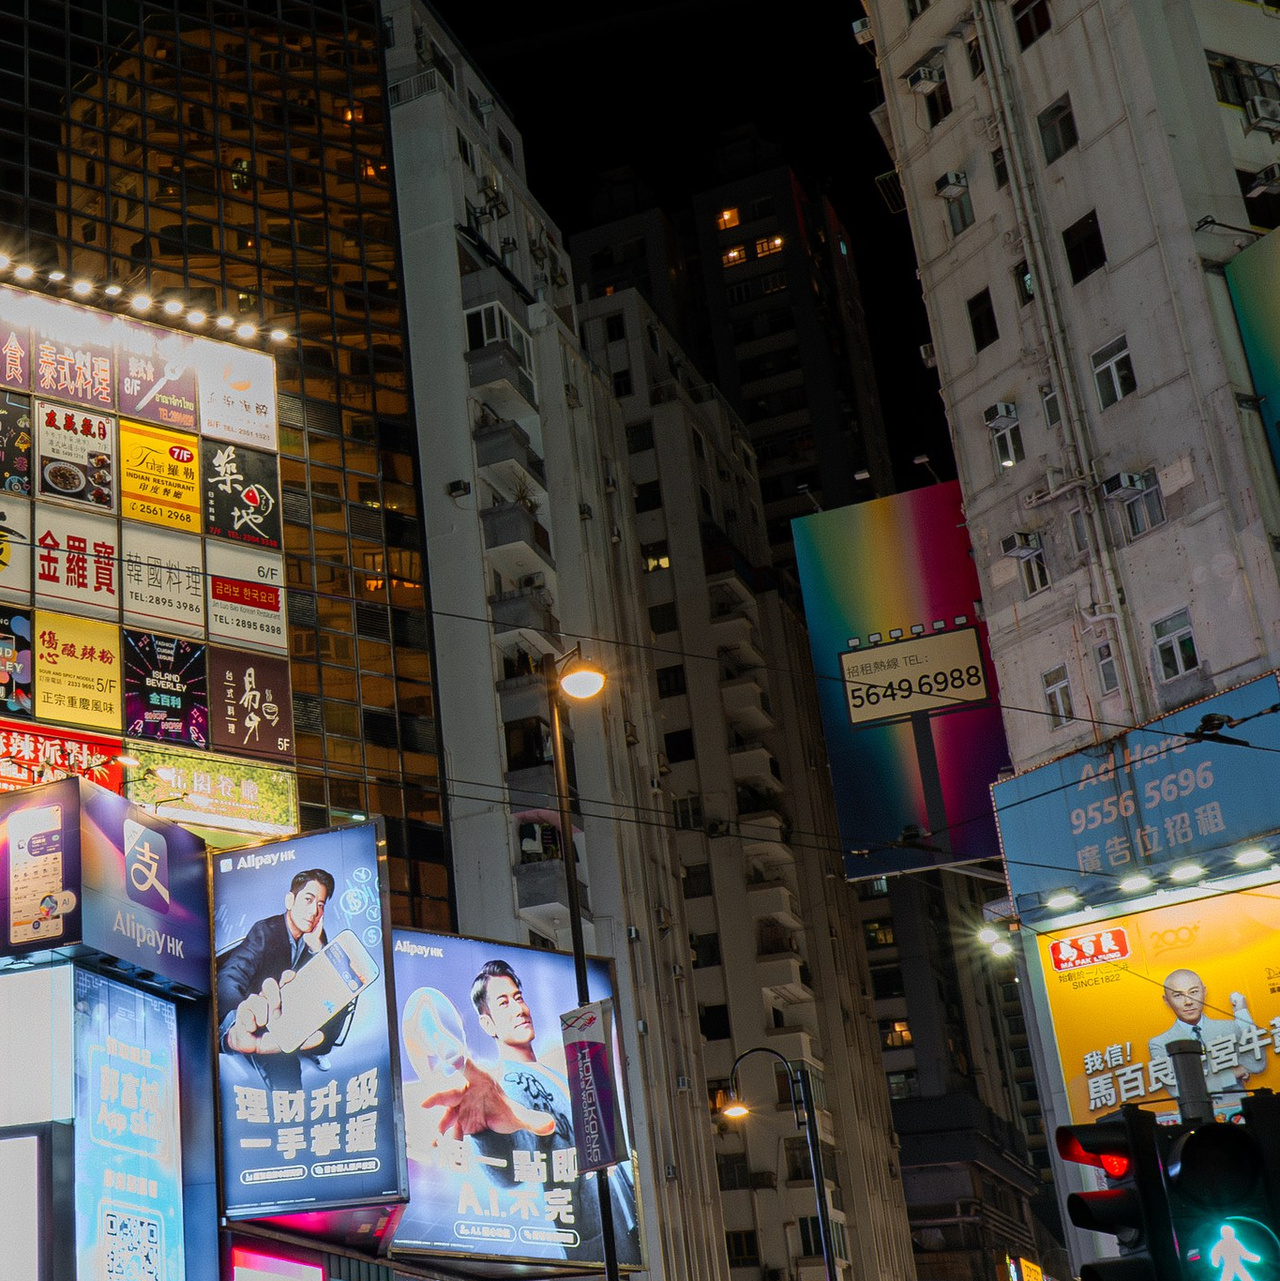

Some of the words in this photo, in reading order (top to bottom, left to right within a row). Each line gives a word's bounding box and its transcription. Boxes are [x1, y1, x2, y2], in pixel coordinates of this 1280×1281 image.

[39, 341, 111, 404] 泰式料理
[124, 377, 141, 396] 8/F
[45, 410, 96, 438] 友義氣
[172, 447, 191, 460] 7/F
[126, 471, 150, 483] INDIAN
[153, 478, 195, 492] RESTAURANT
[167, 463, 195, 480] 羅勒
[138, 483, 182, 500] 印度餐廳
[140, 503, 163, 517] 2561
[168, 510, 191, 523] 2968
[38, 530, 115, 596] 金羅寶
[126, 551, 202, 597] 韓國料理
[257, 565, 278, 580] 6/F
[215, 581, 239, 598] 금라보
[243, 588, 276, 605] 한국요리
[176, 602, 201, 614] 3986
[259, 621, 282, 635] 6398
[152, 670, 180, 682] ISLAND
[846, 657, 900, 679] 招租熱線
[96, 677, 117, 694] 5/F
[145, 677, 187, 692] BEVERLEY
[851, 678, 913, 709] 5649
[918, 665, 982, 695] 6988
[41, 691, 116, 715] 正宗重慶風味
[149, 692, 182, 709] 金百利
[225, 670, 236, 734] 台式料理
[277, 738, 291, 751] 5F
[1077, 753, 1115, 791] Ad
[1124, 734, 1187, 774] Here
[1070, 790, 1136, 835] 9556
[1144, 760, 1214, 810] 5696
[1076, 801, 1226, 877] 廣告位招租
[237, 849, 296, 870] AlipayHK
[62, 898, 70, 906] AI
[113, 910, 184, 959] AlipayHK
[1058, 931, 1120, 962] 馬百良
[394, 939, 443, 958] AlipayHK
[1060, 961, 1074, 970] MA
[1075, 957, 1092, 967] PAK
[1084, 1041, 1132, 1074] 我信!
[577, 1052, 585, 1088] ASIA'S
[582, 1048, 596, 1103] HONG
[234, 1067, 378, 1123] 理財升級
[97, 1102, 127, 1137] App
[581, 1092, 591, 1134] WORLD
[240, 1111, 377, 1160] 一手掌握
[587, 1106, 601, 1162] KONG
[585, 1137, 593, 1162] CITY
